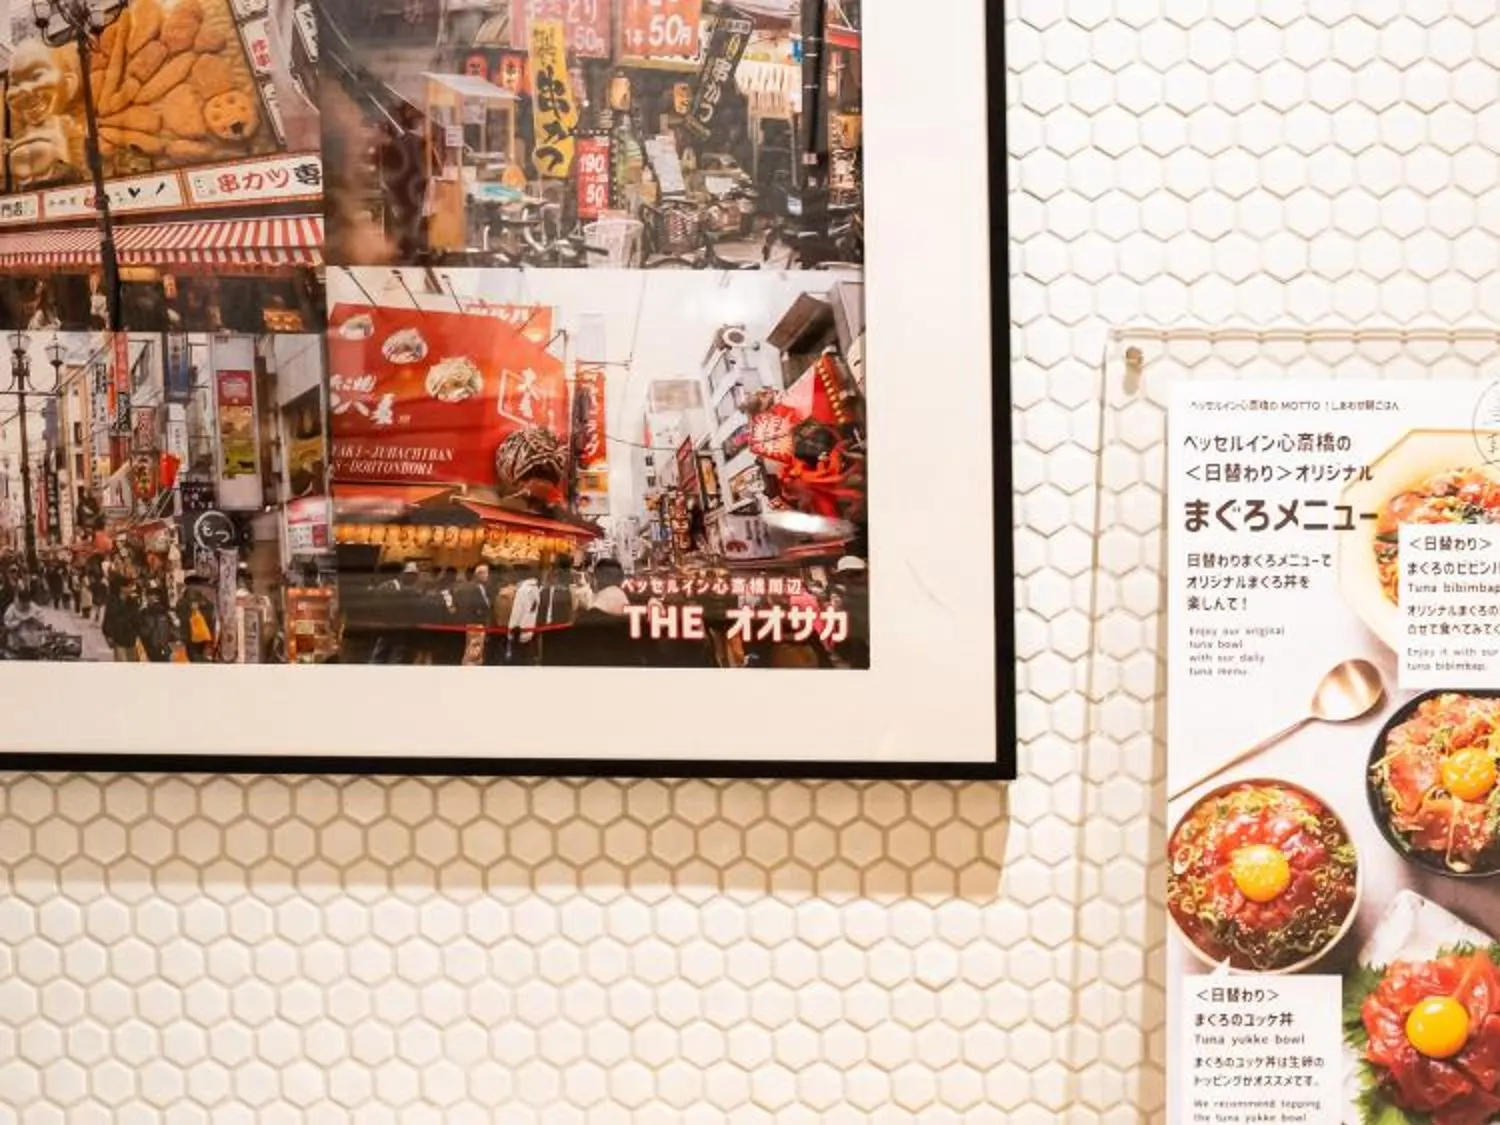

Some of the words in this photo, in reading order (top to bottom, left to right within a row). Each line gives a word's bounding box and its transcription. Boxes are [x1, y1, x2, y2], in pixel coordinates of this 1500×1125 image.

[1184, 432, 1352, 452] ベッセルイン心斎橋の
[1184, 499, 1379, 532] まぐろメニュー
[1187, 552, 1332, 568] 日替わりまぐろメニューで
[1187, 575, 1310, 589] オリジナルまぐろ丼を
[1408, 583, 1437, 593] Tuna
[623, 606, 704, 639] THE
[726, 605, 848, 641] オオサカ
[1217, 640, 1243, 649] bowl
[1194, 1012, 1294, 1027] まぐろのユッケ丼
[1194, 1034, 1225, 1045] Tuna
[1231, 1034, 1269, 1047] yukke
[1275, 1034, 1305, 1045] bowl
